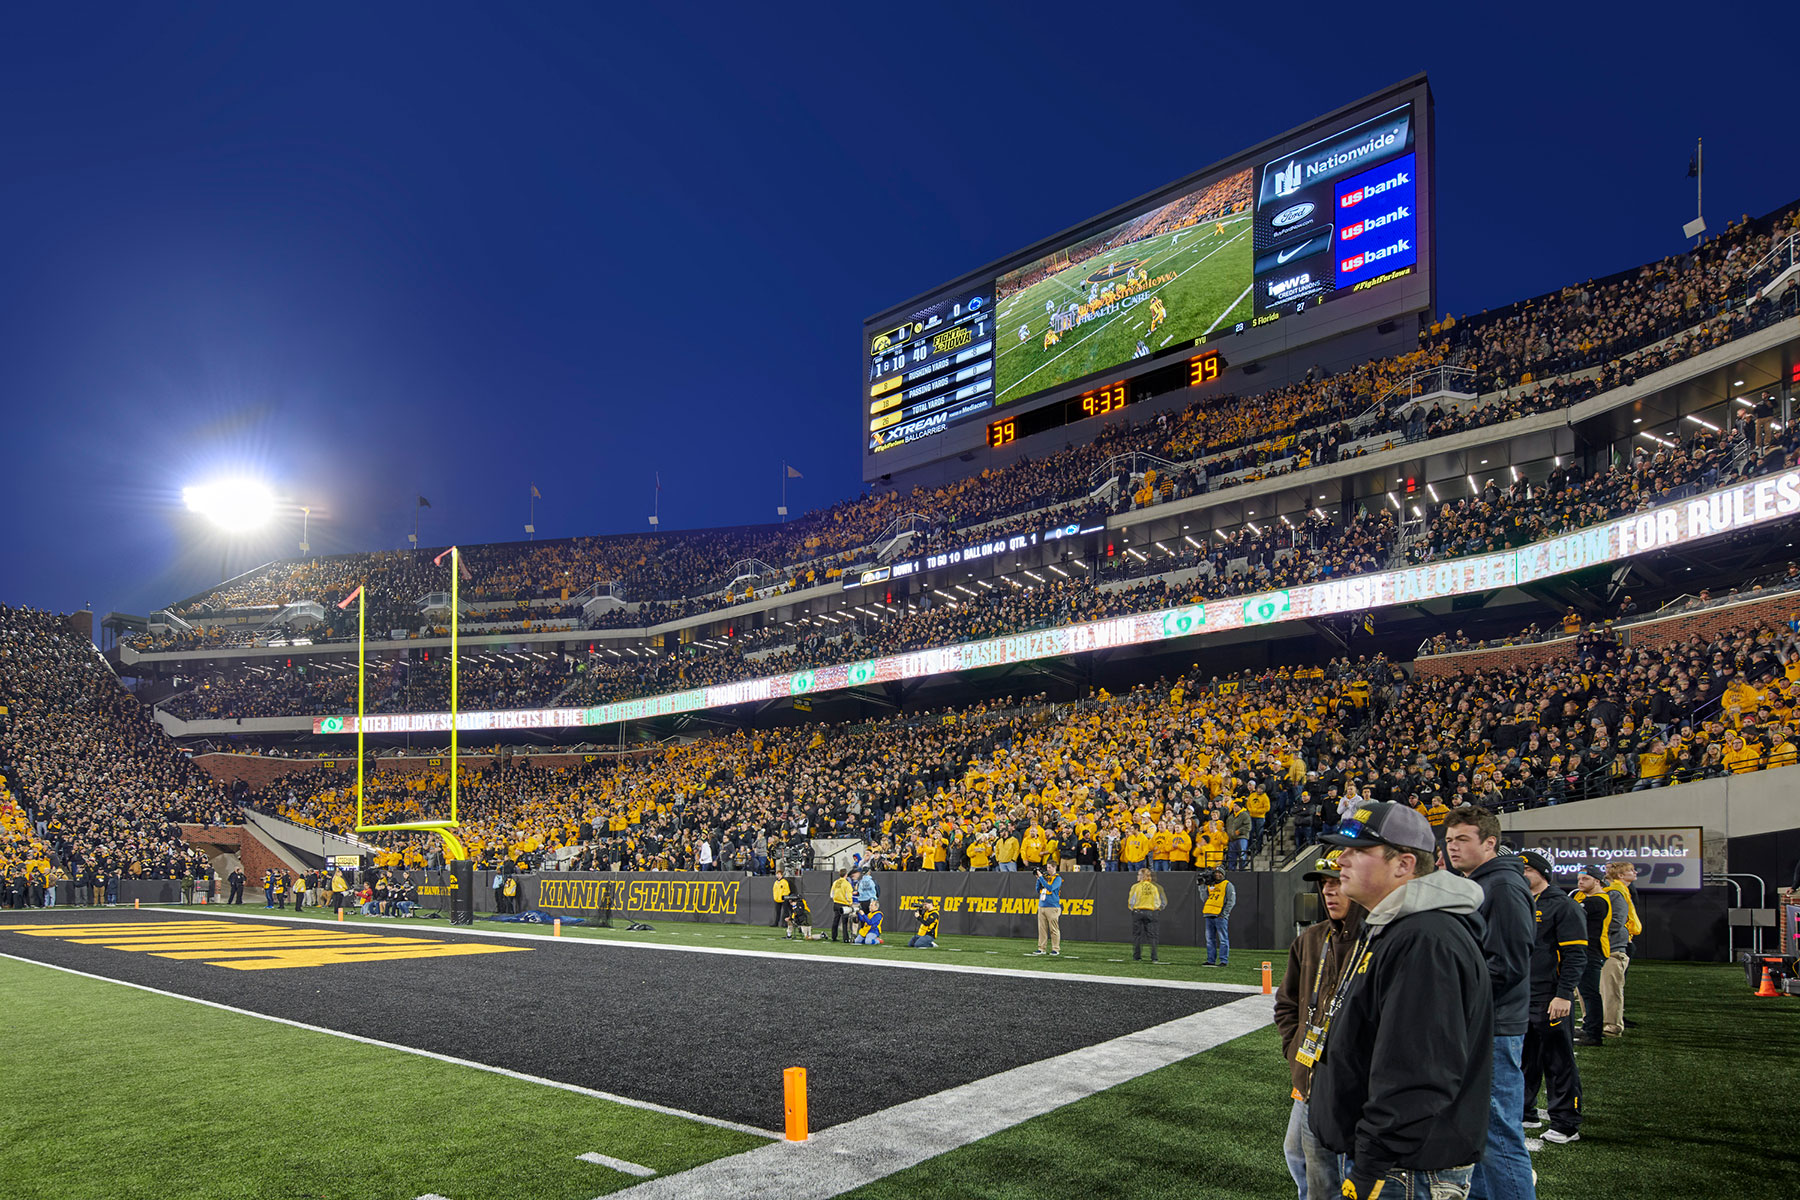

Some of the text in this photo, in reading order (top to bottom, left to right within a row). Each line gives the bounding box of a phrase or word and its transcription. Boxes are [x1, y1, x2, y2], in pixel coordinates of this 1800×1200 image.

[1306, 132, 1396, 177] Nationwide
[1121, 290, 1151, 308] CARE
[1279, 287, 1298, 299] CREDIT
[954, 303, 960, 317] 0
[1235, 323, 1244, 332] 23
[1258, 312, 1279, 326] Florida
[1296, 302, 1305, 312] 27
[899, 327, 905, 340] 0
[978, 322, 985, 337] 1
[876, 363, 882, 377] 1
[893, 354, 905, 371] 10
[913, 346, 927, 362] 40
[932, 359, 949, 372] YARDS
[1191, 357, 1218, 386] 39
[932, 377, 949, 390] YARDS
[912, 402, 928, 415] TOTAL
[928, 397, 945, 410] YARDS
[1083, 387, 1125, 416] 9:33
[887, 412, 948, 441] XTREAM
[993, 422, 1014, 447] 39
[1322, 577, 1386, 611] VISIT
[1618, 508, 1679, 557] FOR
[1687, 473, 1800, 539] RULES
[893, 562, 912, 577] DOWN
[914, 561, 919, 572] 1
[927, 556, 937, 568] TO
[937, 554, 947, 567] GO
[949, 552, 960, 563] 10
[964, 546, 981, 560] BALL
[981, 543, 993, 556] ON
[993, 541, 1006, 553] 40
[1031, 533, 1037, 544] 1
[1055, 528, 1062, 538] 0
[961, 640, 1000, 668] CASH
[1006, 631, 1062, 661] PRIZES
[1067, 625, 1089, 652] TO
[1218, 682, 1239, 695] 137
[354, 716, 388, 732] ENTER
[391, 714, 437, 731] HOLIDAY
[494, 710, 540, 728] TICKETS
[559, 708, 580, 727] THE
[607, 700, 644, 723] LOTTERY
[323, 761, 336, 769] 132
[428, 758, 442, 767] 133
[1537, 834, 1685, 852] STREAMING
[1555, 847, 1587, 858] Iowa
[1589, 847, 1637, 860] Toyota
[1640, 847, 1689, 858] Dealer
[539, 879, 740, 915] KINNICK STADIUM
[943, 896, 963, 912] OF
[966, 896, 999, 913] THE
[1000, 898, 1094, 916] HAWYES
